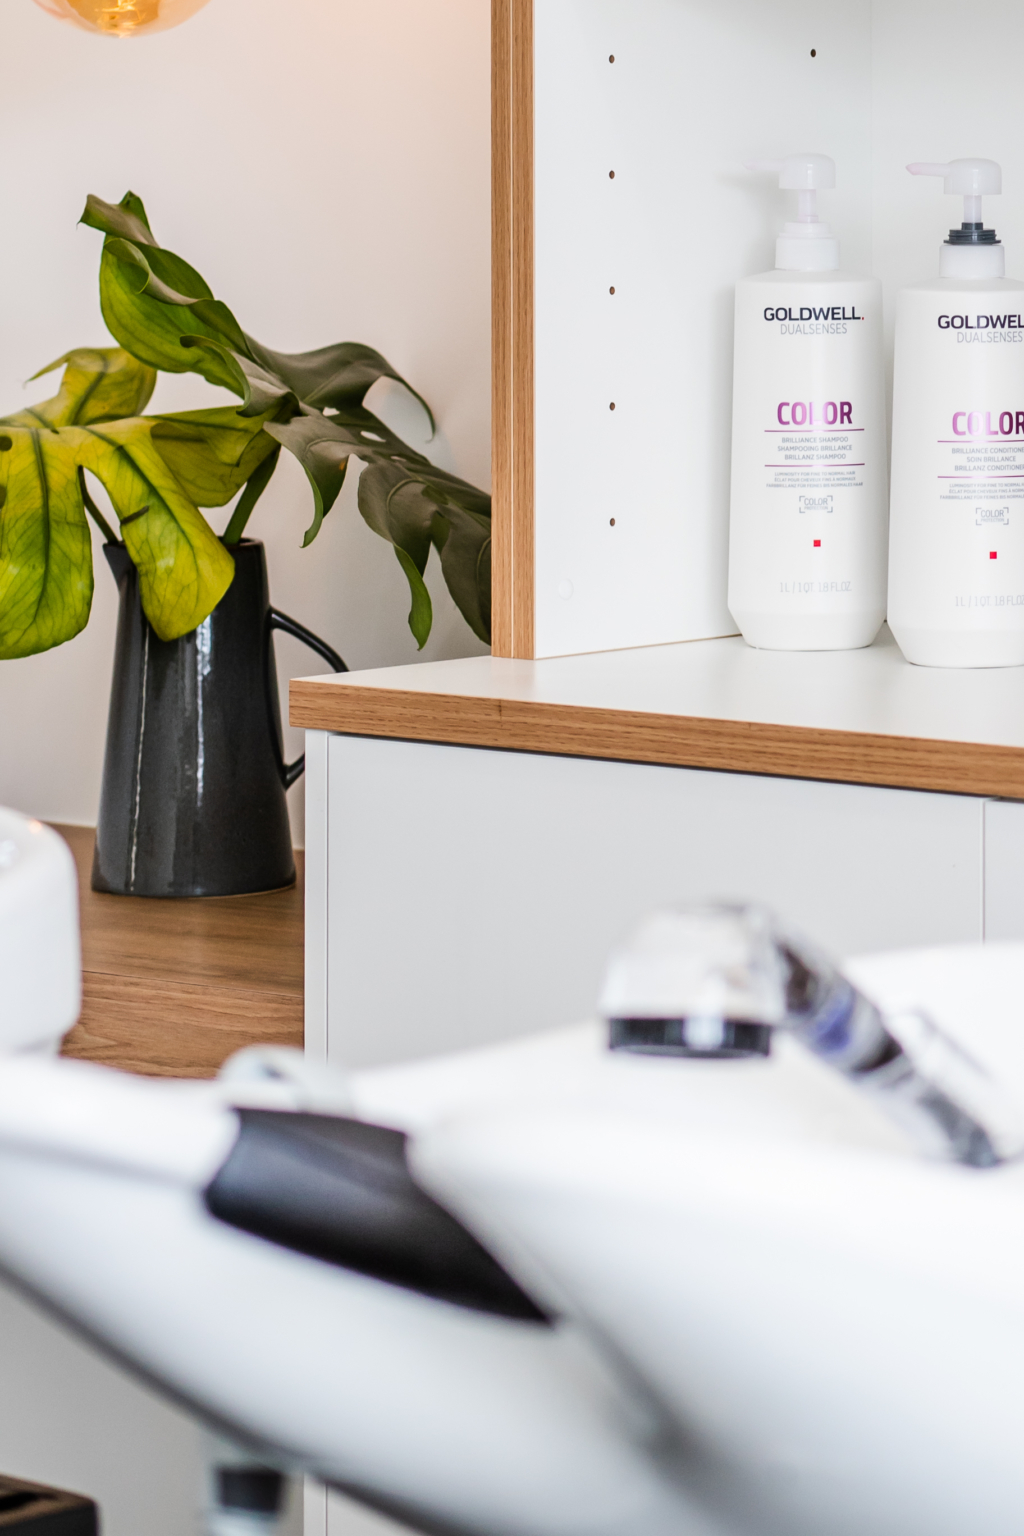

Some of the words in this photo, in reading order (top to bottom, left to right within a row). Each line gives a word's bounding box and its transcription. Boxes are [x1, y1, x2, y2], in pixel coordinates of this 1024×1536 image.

[780, 323, 848, 335] DUALSENSES
[957, 331, 1023, 343] DUALSENSES
[777, 401, 853, 425] COLOR
[804, 498, 828, 506] COLOR
[981, 509, 1004, 517] COLOR
